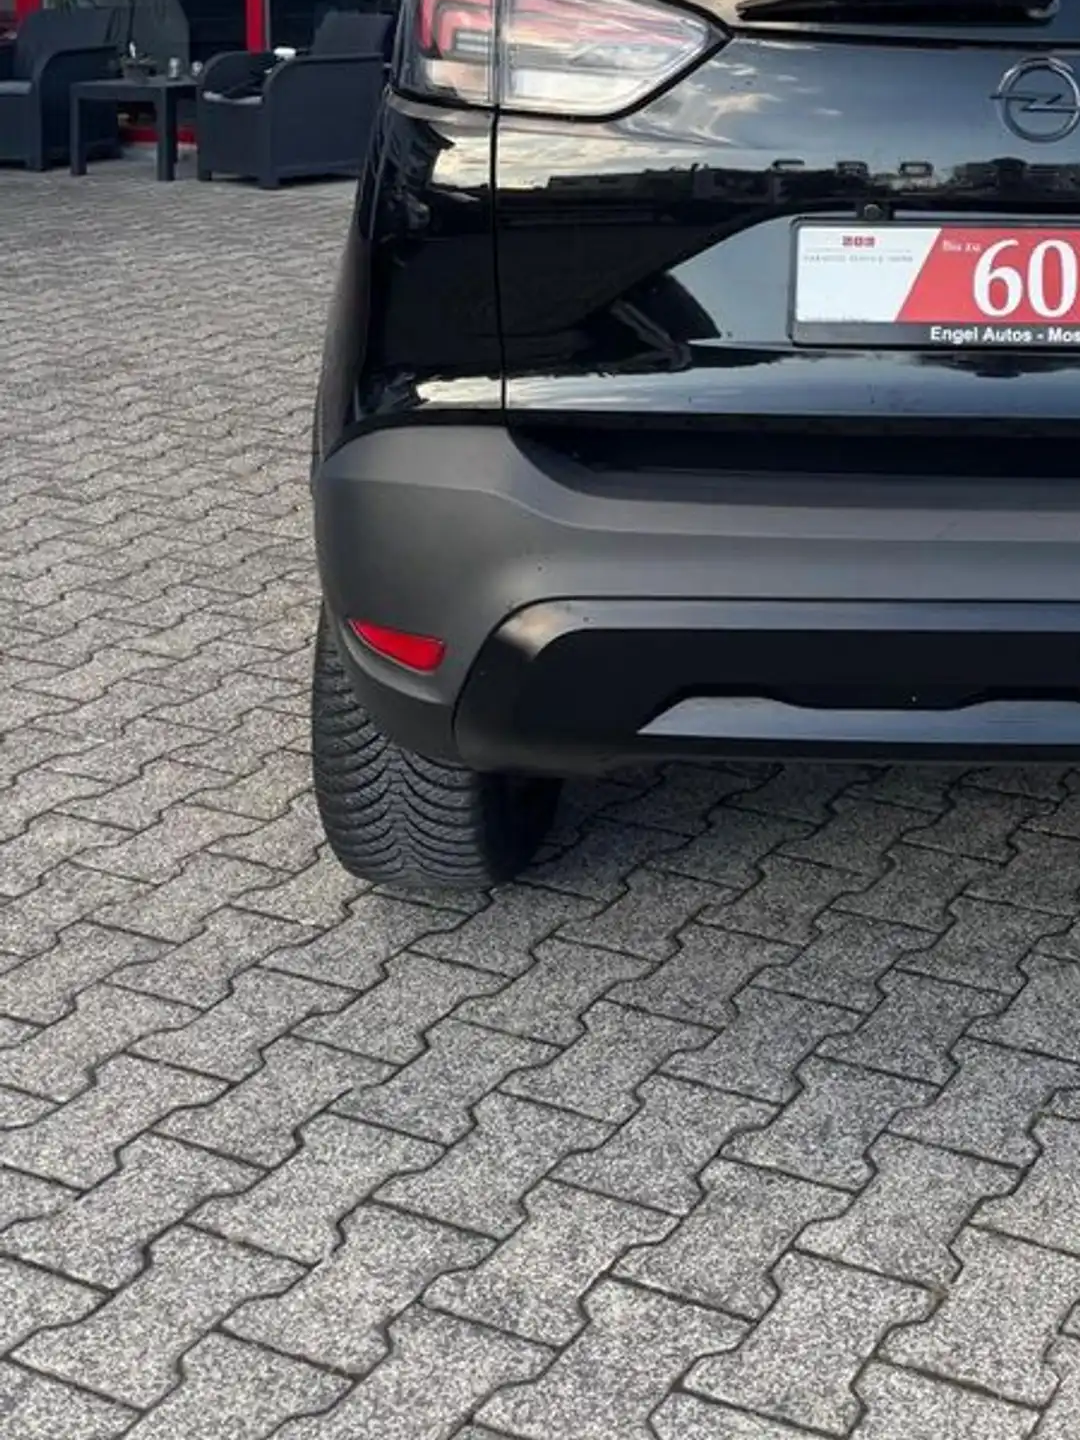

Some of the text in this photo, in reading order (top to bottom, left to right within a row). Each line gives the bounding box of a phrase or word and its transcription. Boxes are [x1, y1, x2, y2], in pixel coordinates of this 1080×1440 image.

[973, 239, 1078, 317] 60
[930, 326, 978, 344] Engel
[982, 328, 1032, 342] Autos
